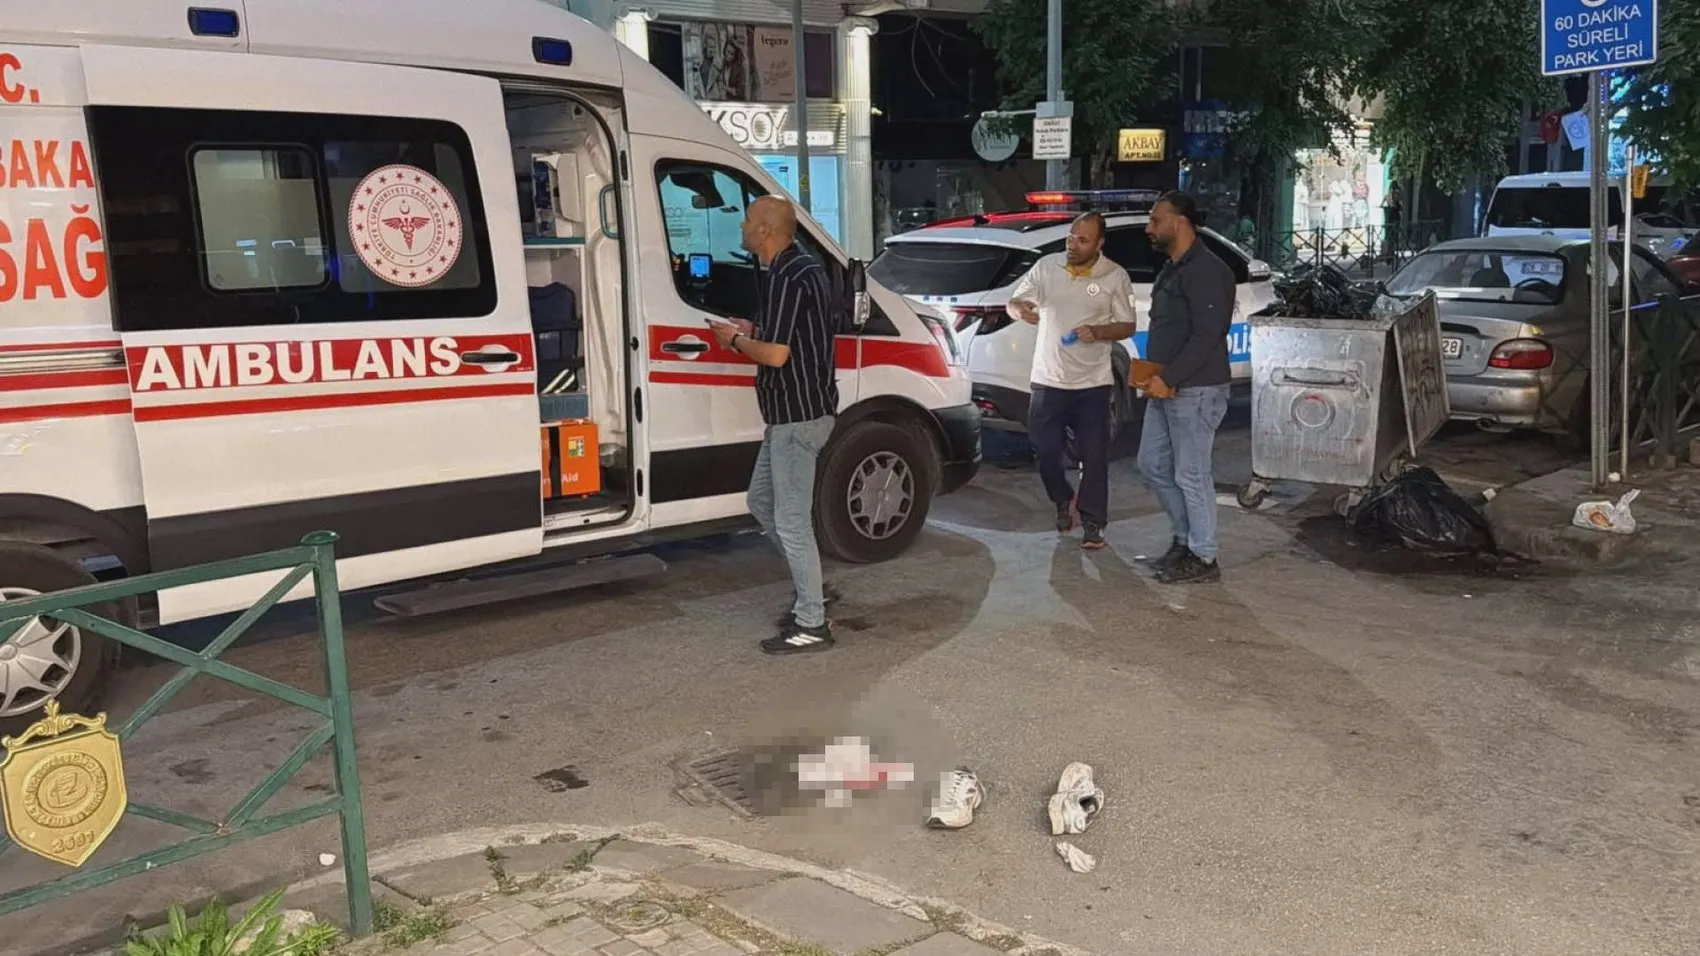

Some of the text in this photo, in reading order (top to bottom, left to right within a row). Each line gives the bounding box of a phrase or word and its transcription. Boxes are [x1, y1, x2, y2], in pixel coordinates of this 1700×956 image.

[1555, 4, 1642, 31] 60 DAKİKA
[1567, 23, 1629, 48] SÜRELİ
[1554, 40, 1643, 69] PARK YERİ
[1123, 136, 1162, 149] AKBAY
[0, 140, 95, 188] AKA
[1442, 340, 1458, 353] 28
[136, 337, 460, 392] AMBULANS
[561, 472, 579, 483] Aid
